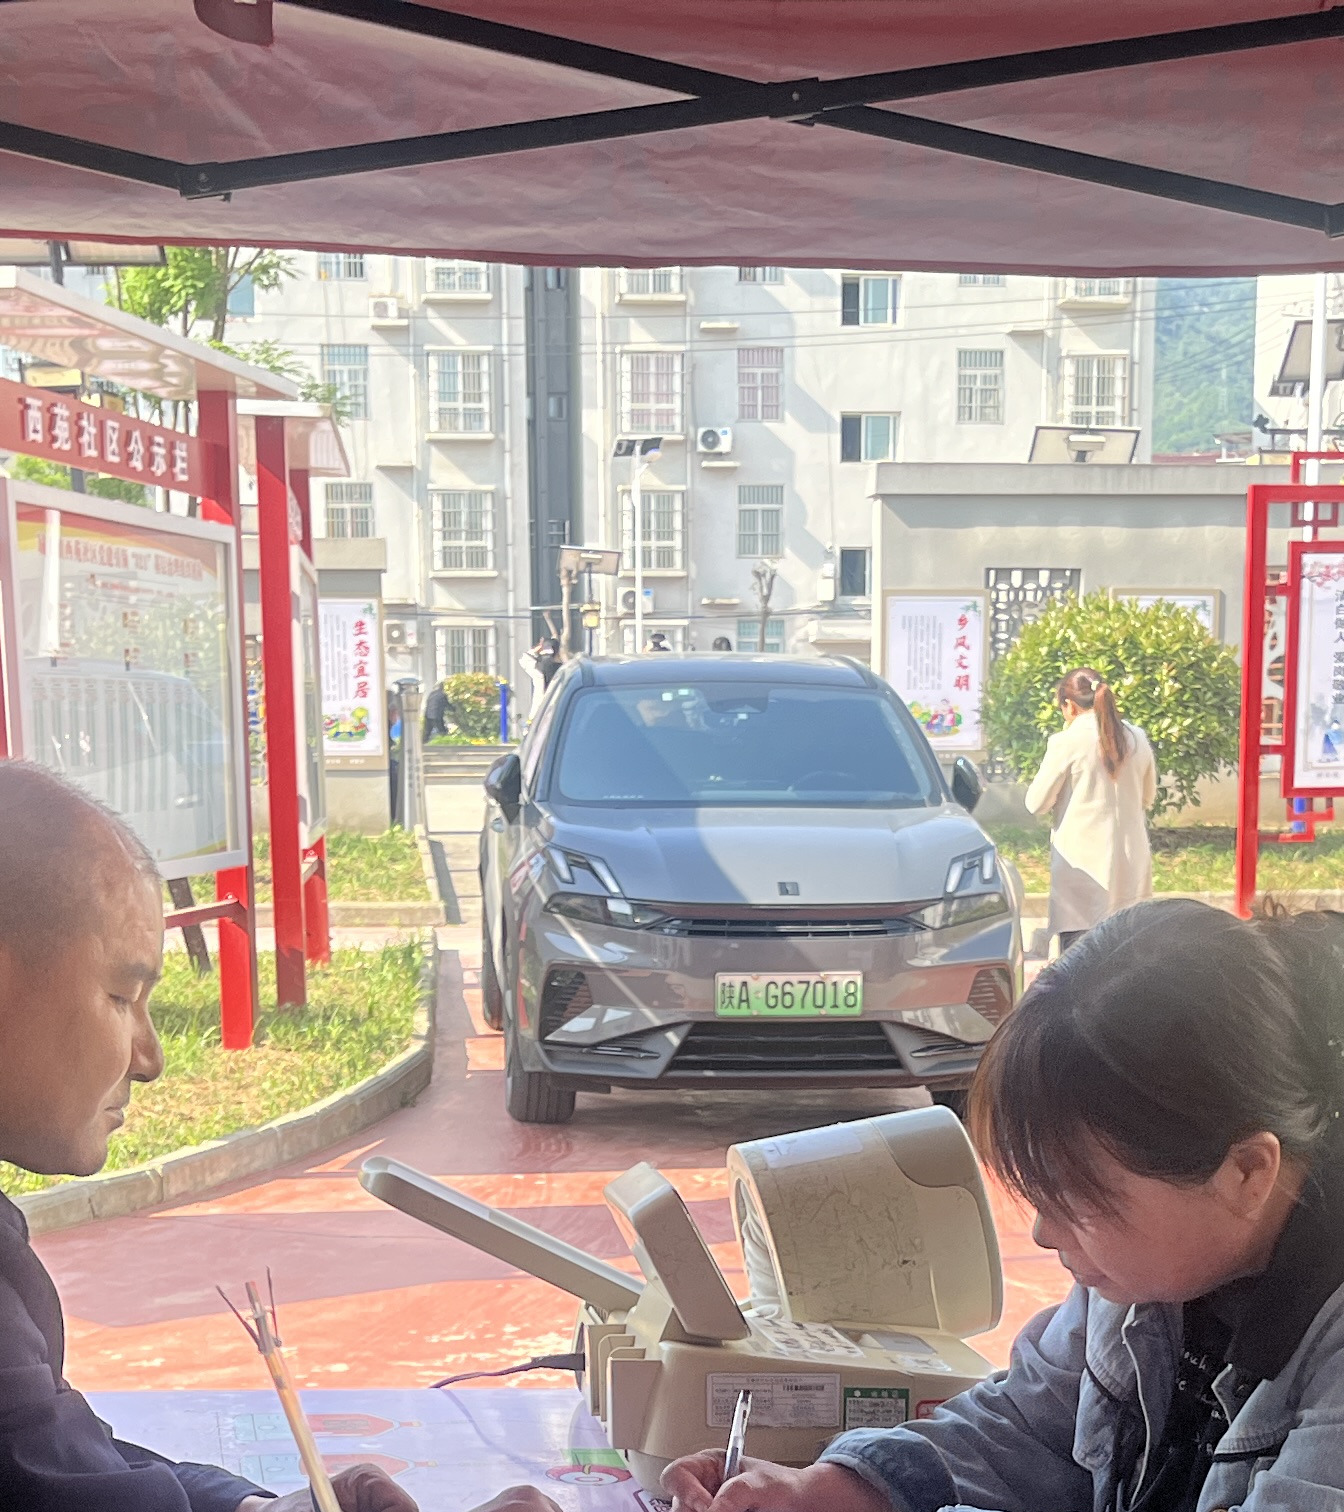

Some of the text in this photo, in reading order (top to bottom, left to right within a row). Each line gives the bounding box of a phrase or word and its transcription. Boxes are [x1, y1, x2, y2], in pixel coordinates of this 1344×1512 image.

[23, 397, 189, 483] 西苑社区公示栏
[353, 620, 371, 699] 生态宜居
[953, 613, 971, 691] 乡风文明
[720, 980, 858, 1010] 陕A G67018
